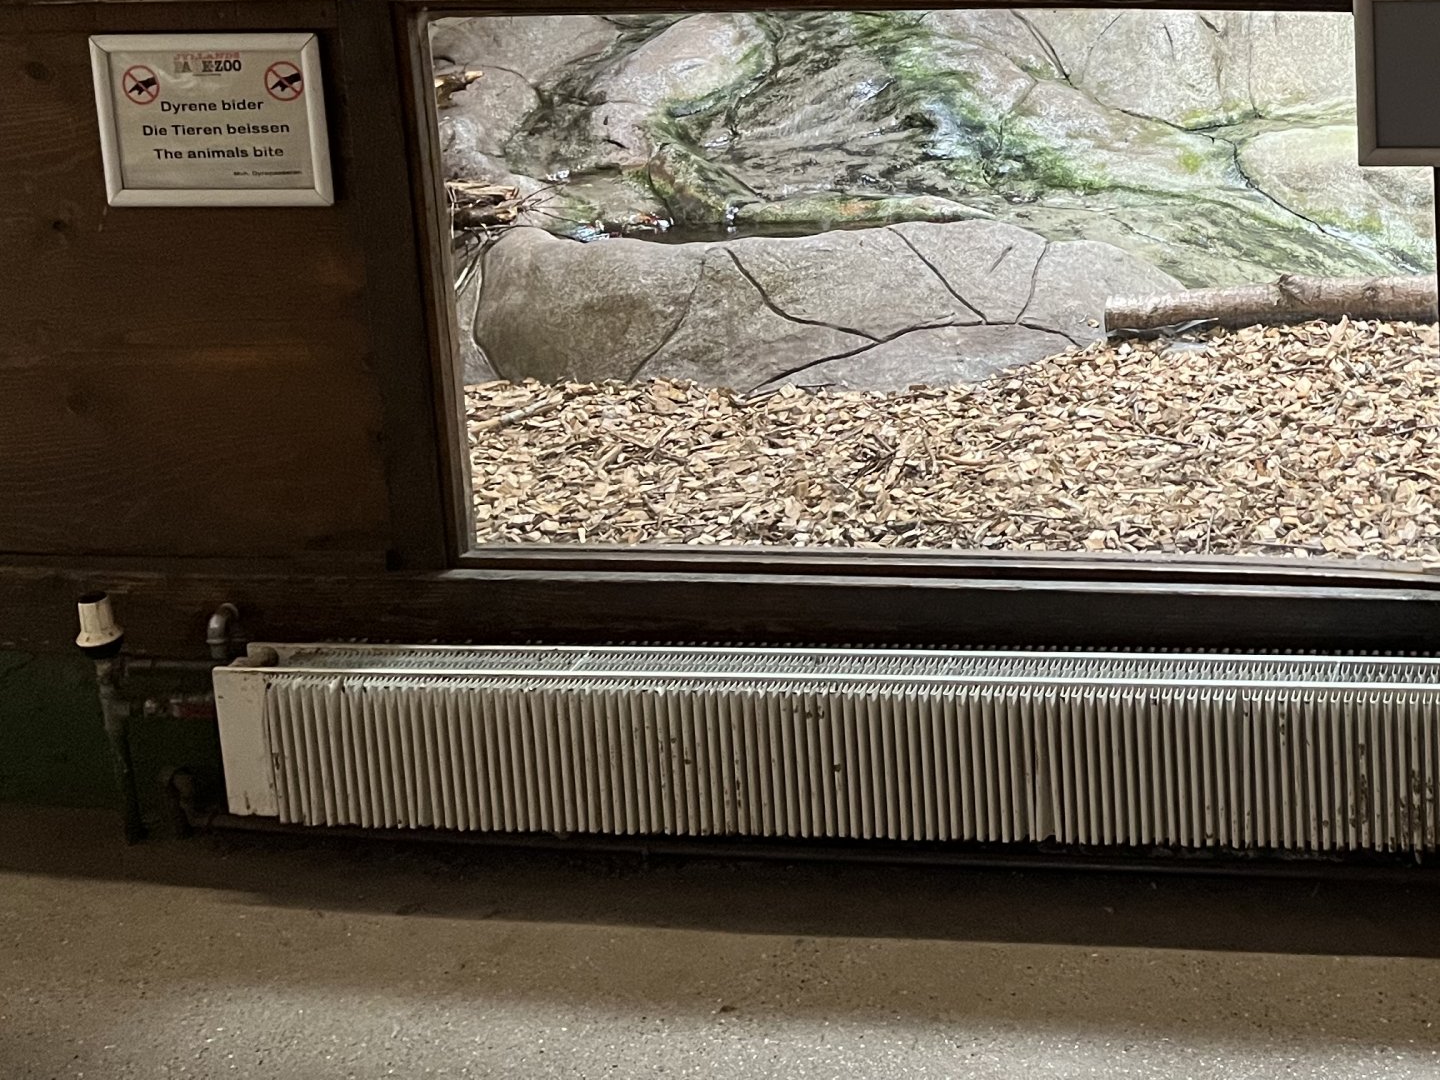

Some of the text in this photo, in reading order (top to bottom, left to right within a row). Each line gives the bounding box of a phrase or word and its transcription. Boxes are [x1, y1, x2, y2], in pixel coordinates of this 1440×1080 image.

[214, 59, 242, 72] ZOO
[160, 99, 264, 115] Dyrene bider
[142, 123, 290, 136] Die Tieren beissen
[154, 146, 284, 160] The animals bite
